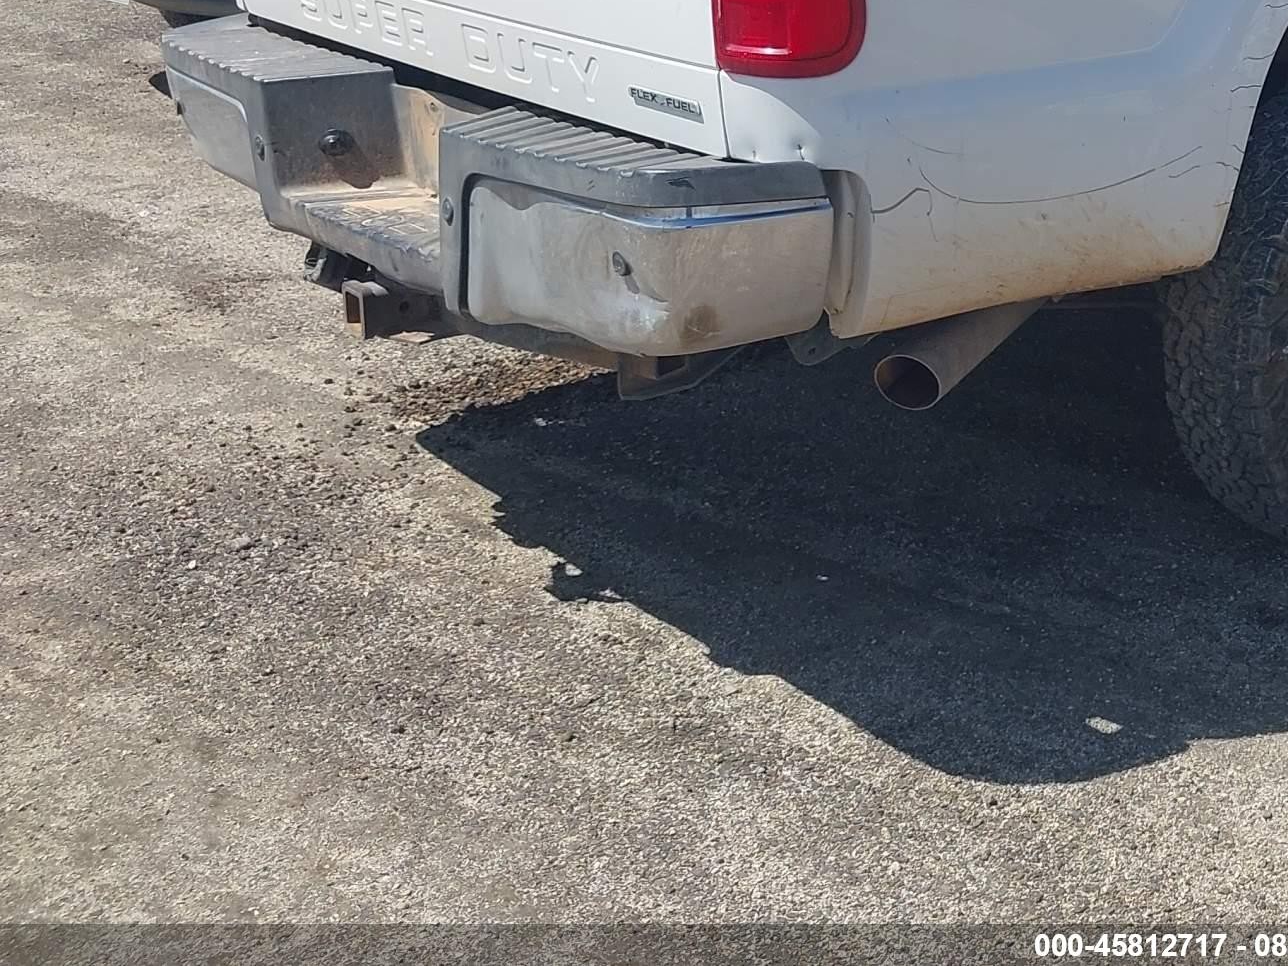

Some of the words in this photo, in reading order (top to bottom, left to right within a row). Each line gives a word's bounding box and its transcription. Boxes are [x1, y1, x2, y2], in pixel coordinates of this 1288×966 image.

[461, 23, 599, 103] DUTY
[630, 87, 658, 103] FLEX
[665, 97, 697, 114] FUEL
